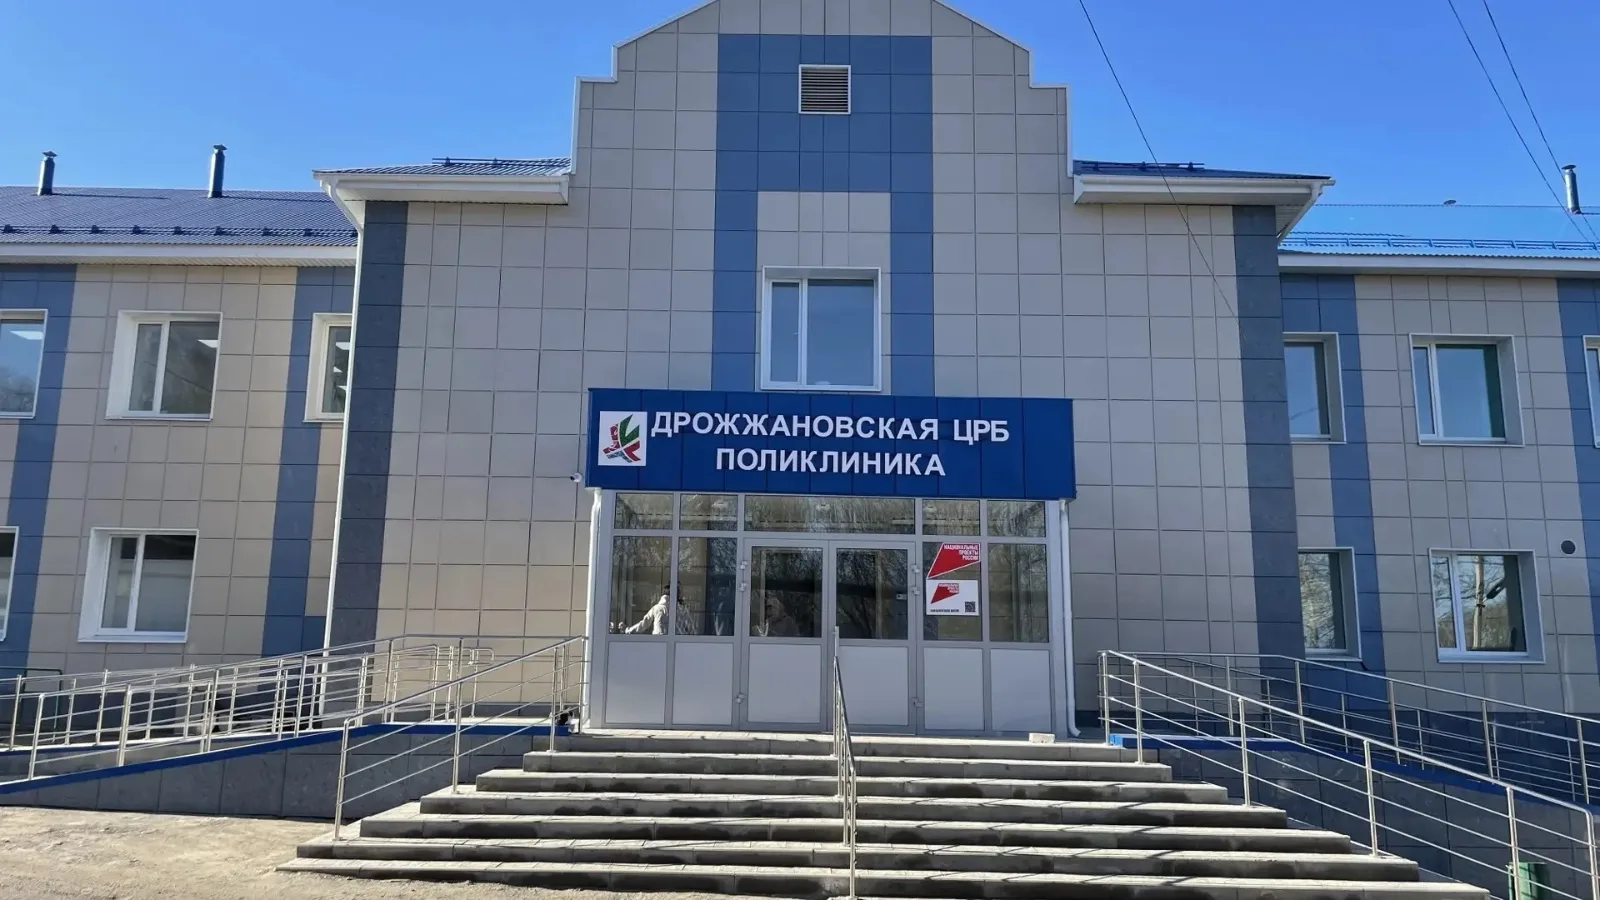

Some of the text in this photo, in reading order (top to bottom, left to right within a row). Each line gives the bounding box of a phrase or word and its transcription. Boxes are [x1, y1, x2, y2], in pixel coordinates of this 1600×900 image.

[651, 411, 1010, 446] ДРОЖЖАНОВСКАЯ ЦРБ
[716, 448, 946, 476] ПОЛИКЛИНИКА
